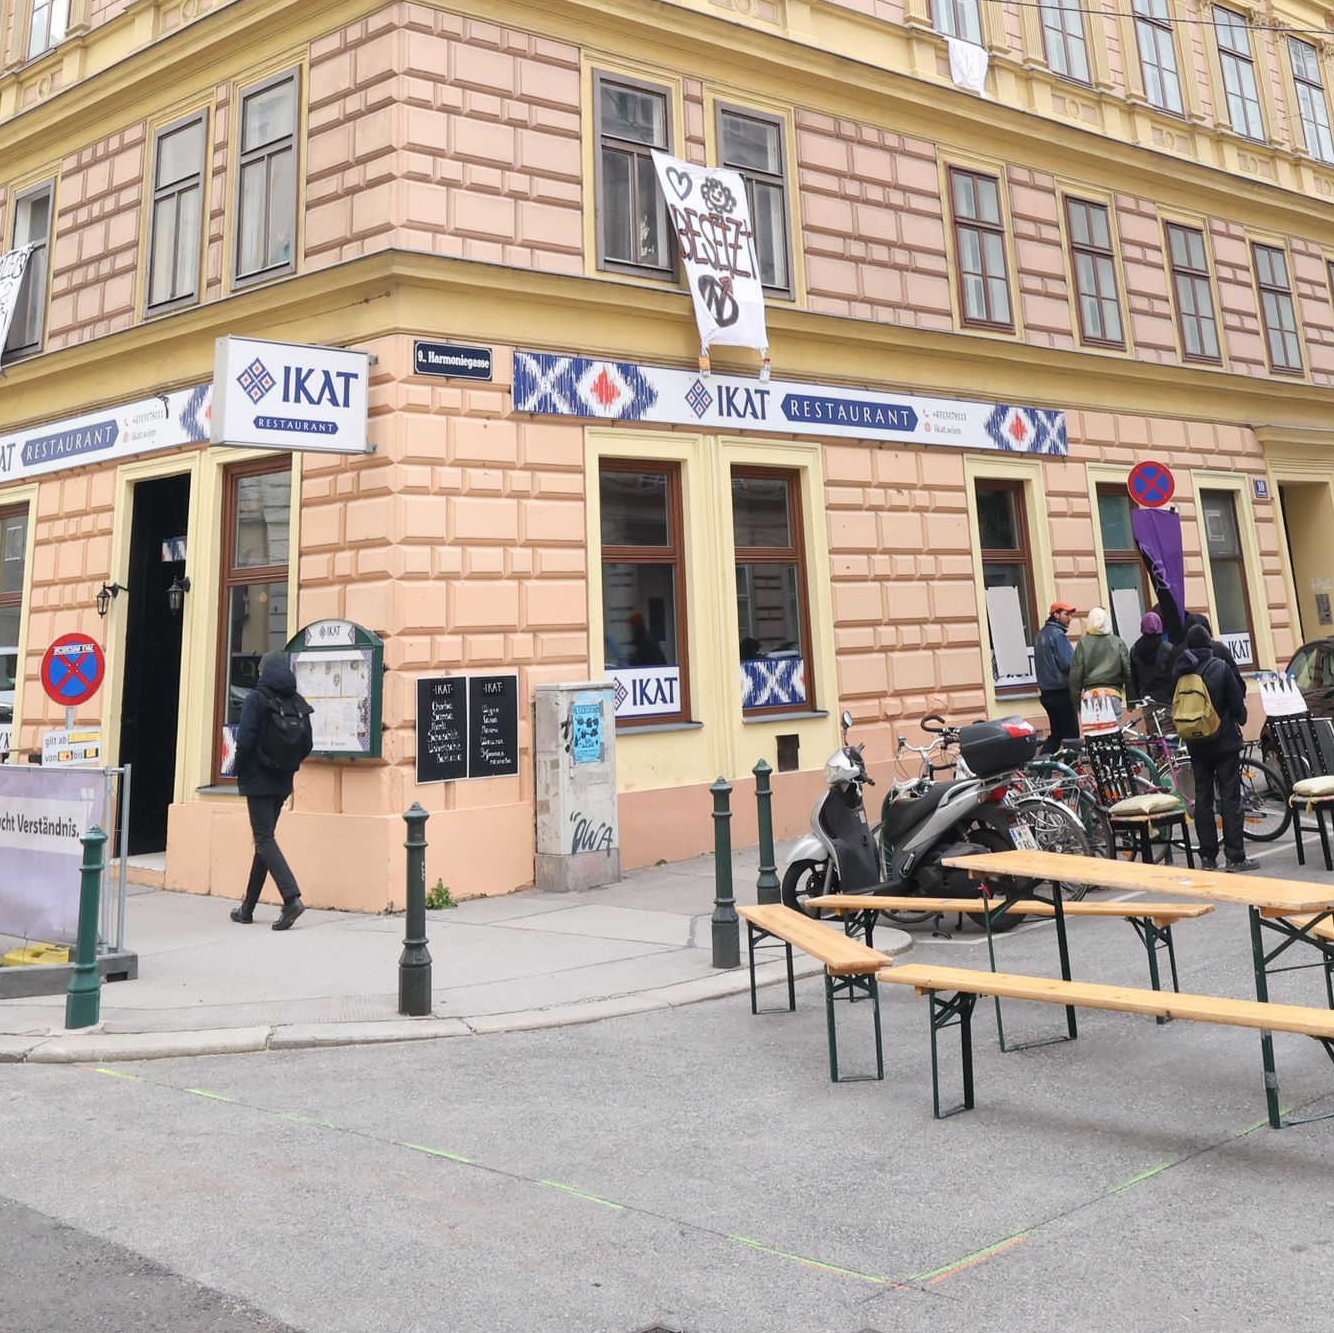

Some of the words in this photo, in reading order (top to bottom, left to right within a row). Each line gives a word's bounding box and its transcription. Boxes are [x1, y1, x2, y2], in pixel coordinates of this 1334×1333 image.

[428, 351, 490, 371] Harmoniegasse
[282, 365, 358, 408] IKAT
[717, 385, 770, 420] IKAT
[790, 399, 910, 427] RESTAURANT
[258, 418, 334, 432] RESTAURANT
[26, 426, 113, 461] RESTAURANT
[327, 625, 340, 636] IKAT
[1228, 639, 1250, 659] IKAT
[632, 677, 678, 707] IKAT
[45, 736, 57, 748] gilt
[58, 735, 67, 745] ab
[45, 753, 57, 763] von
[73, 750, 83, 760] bis
[17, 815, 80, 838] Verständnis.
